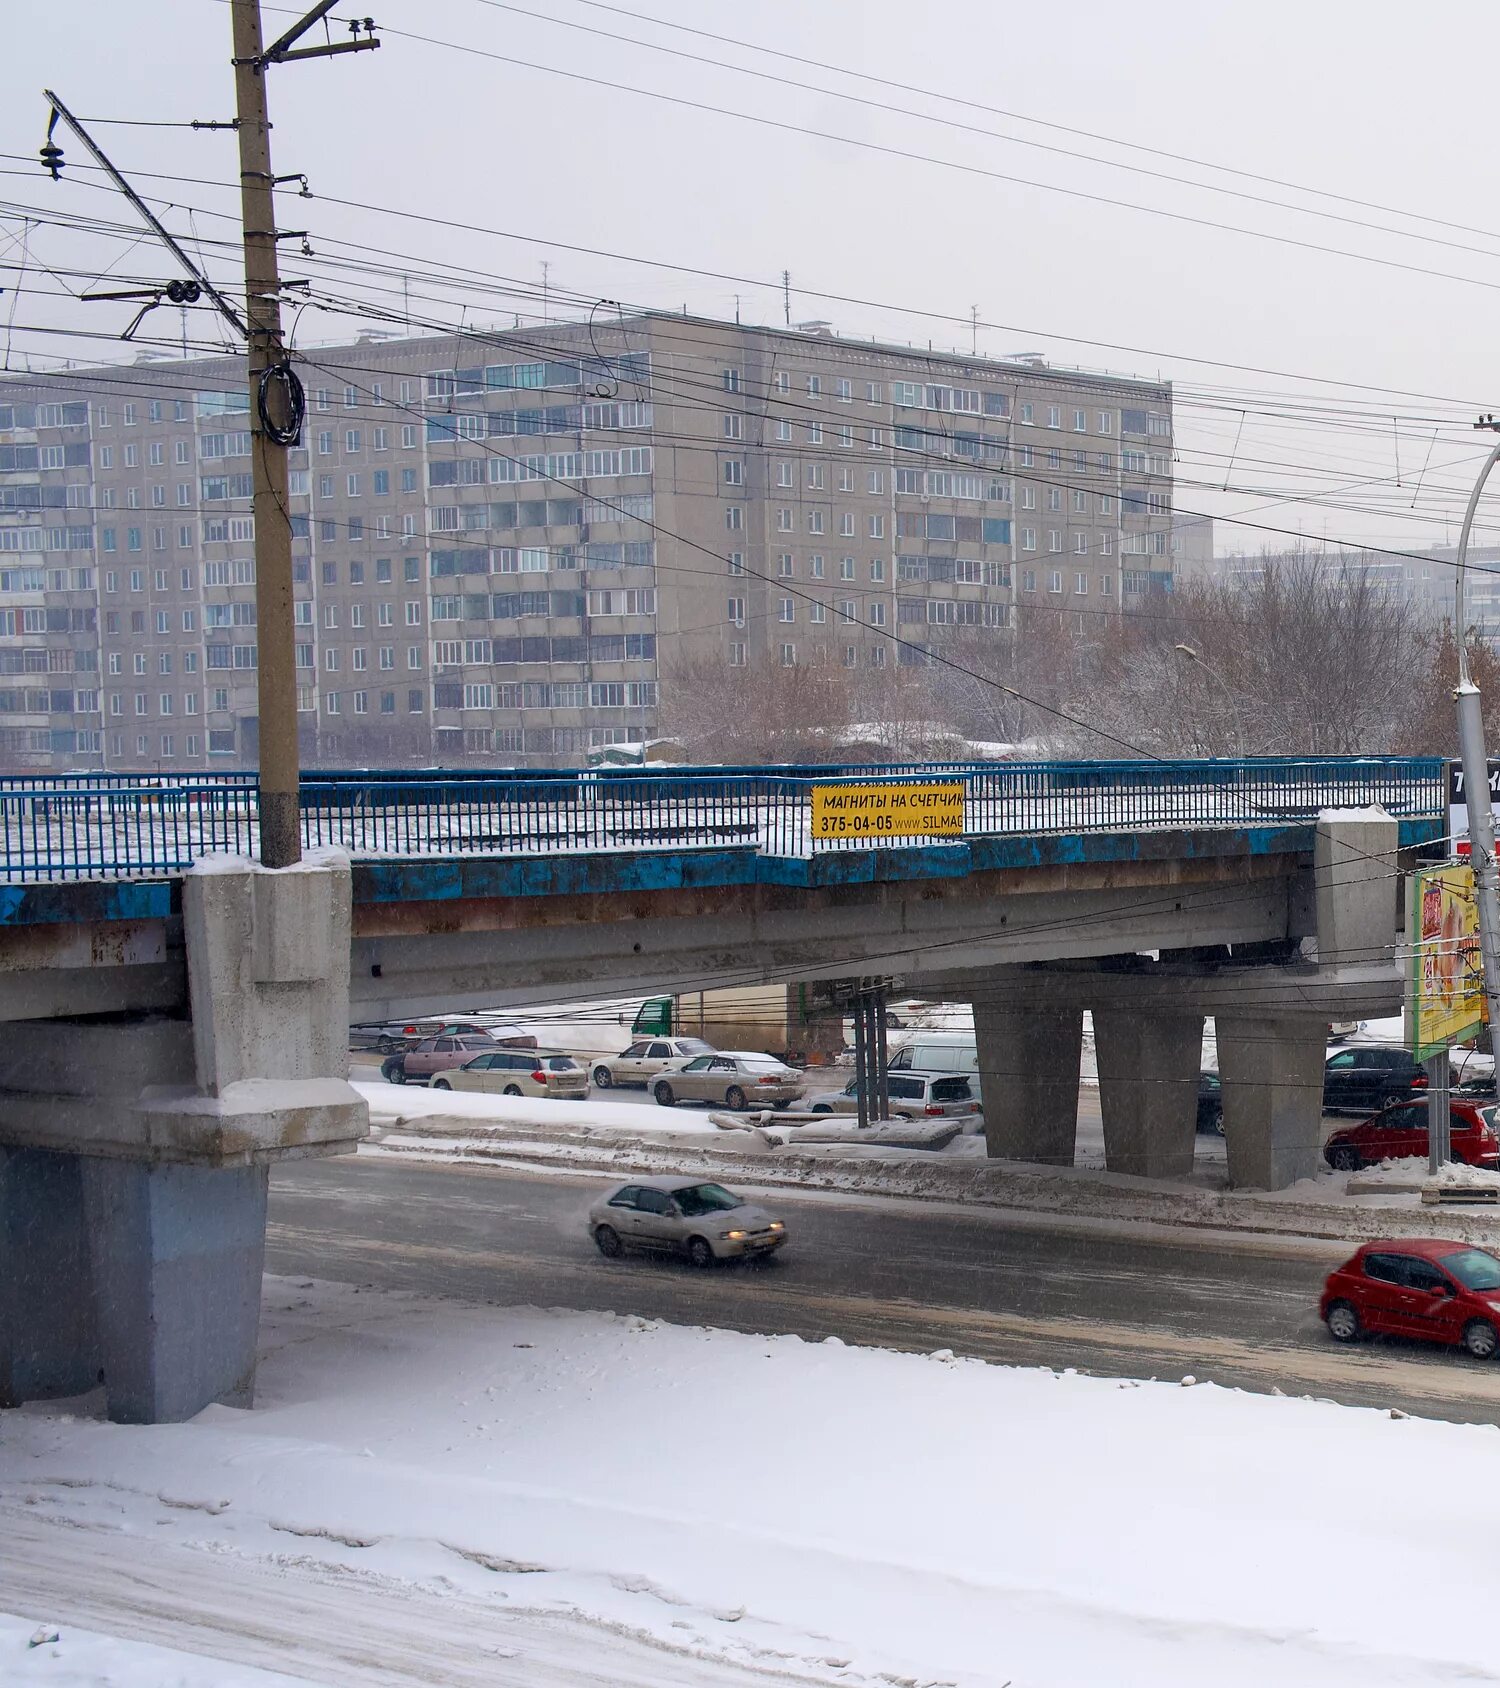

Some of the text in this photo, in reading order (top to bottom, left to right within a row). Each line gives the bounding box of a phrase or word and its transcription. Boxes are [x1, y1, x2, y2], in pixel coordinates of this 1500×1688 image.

[823, 795, 886, 809] МАГНИТЫ
[890, 794, 907, 808] НА
[821, 815, 893, 832] 375-04-05
